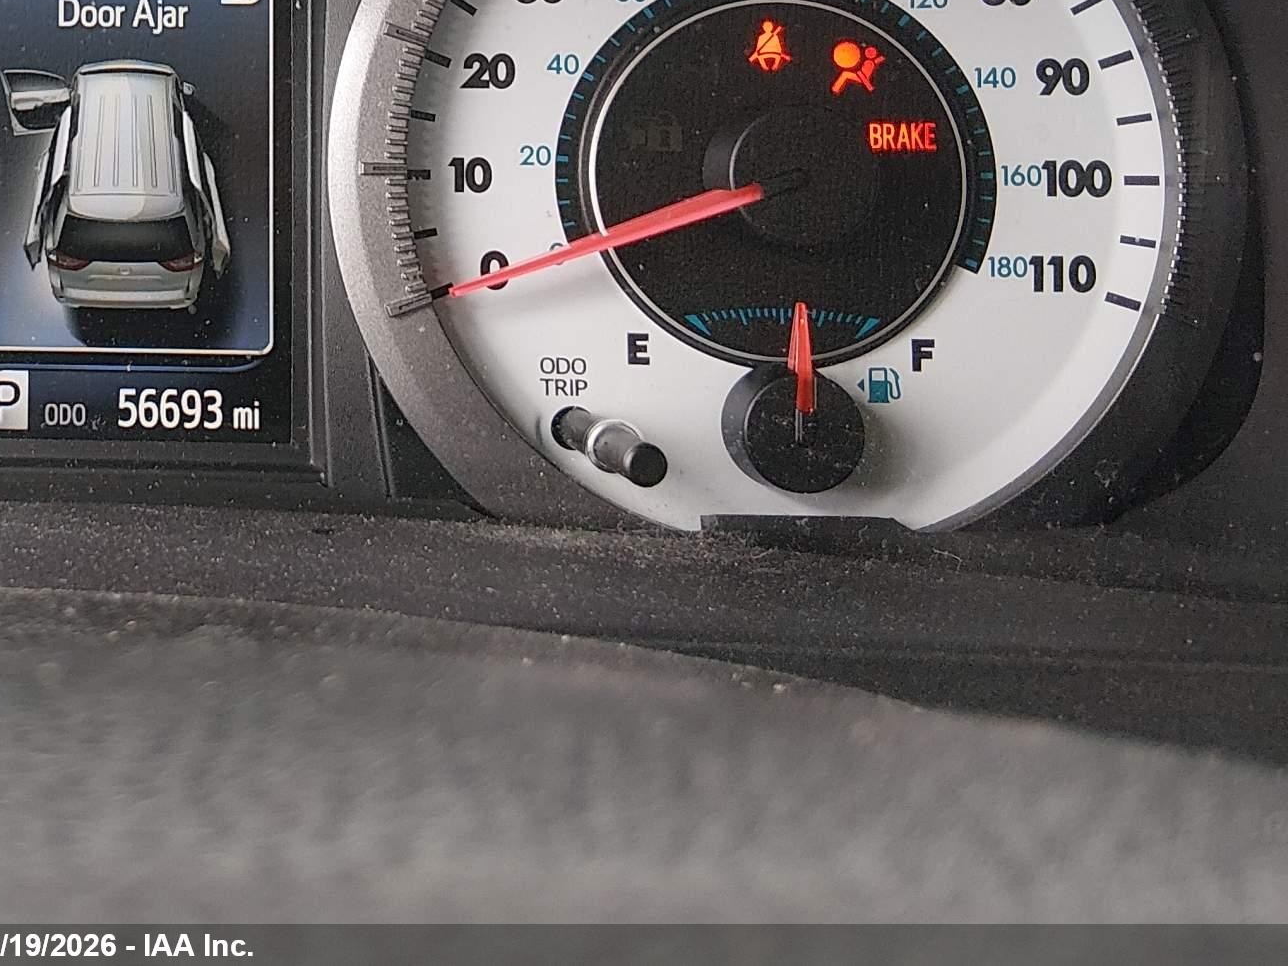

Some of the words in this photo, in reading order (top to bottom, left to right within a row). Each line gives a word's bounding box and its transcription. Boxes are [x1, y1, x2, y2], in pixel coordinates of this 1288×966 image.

[459, 53, 515, 90] 20
[546, 54, 580, 75] 40
[974, 67, 1016, 88] 140
[1036, 58, 1090, 96] 90
[869, 123, 937, 150] BRAKE
[519, 145, 552, 166] 20
[448, 157, 492, 193] 10
[1001, 166, 1041, 186] 160
[1042, 160, 1112, 197] 100
[988, 257, 1028, 278] 180
[1029, 255, 1096, 292] 110
[627, 333, 650, 365] E
[911, 339, 935, 372] F
[540, 357, 586, 375] ODO
[540, 378, 588, 396] TRIP
[43, 403, 86, 426] ODO
[118, 388, 223, 430] 56693
[233, 401, 259, 430] mi
